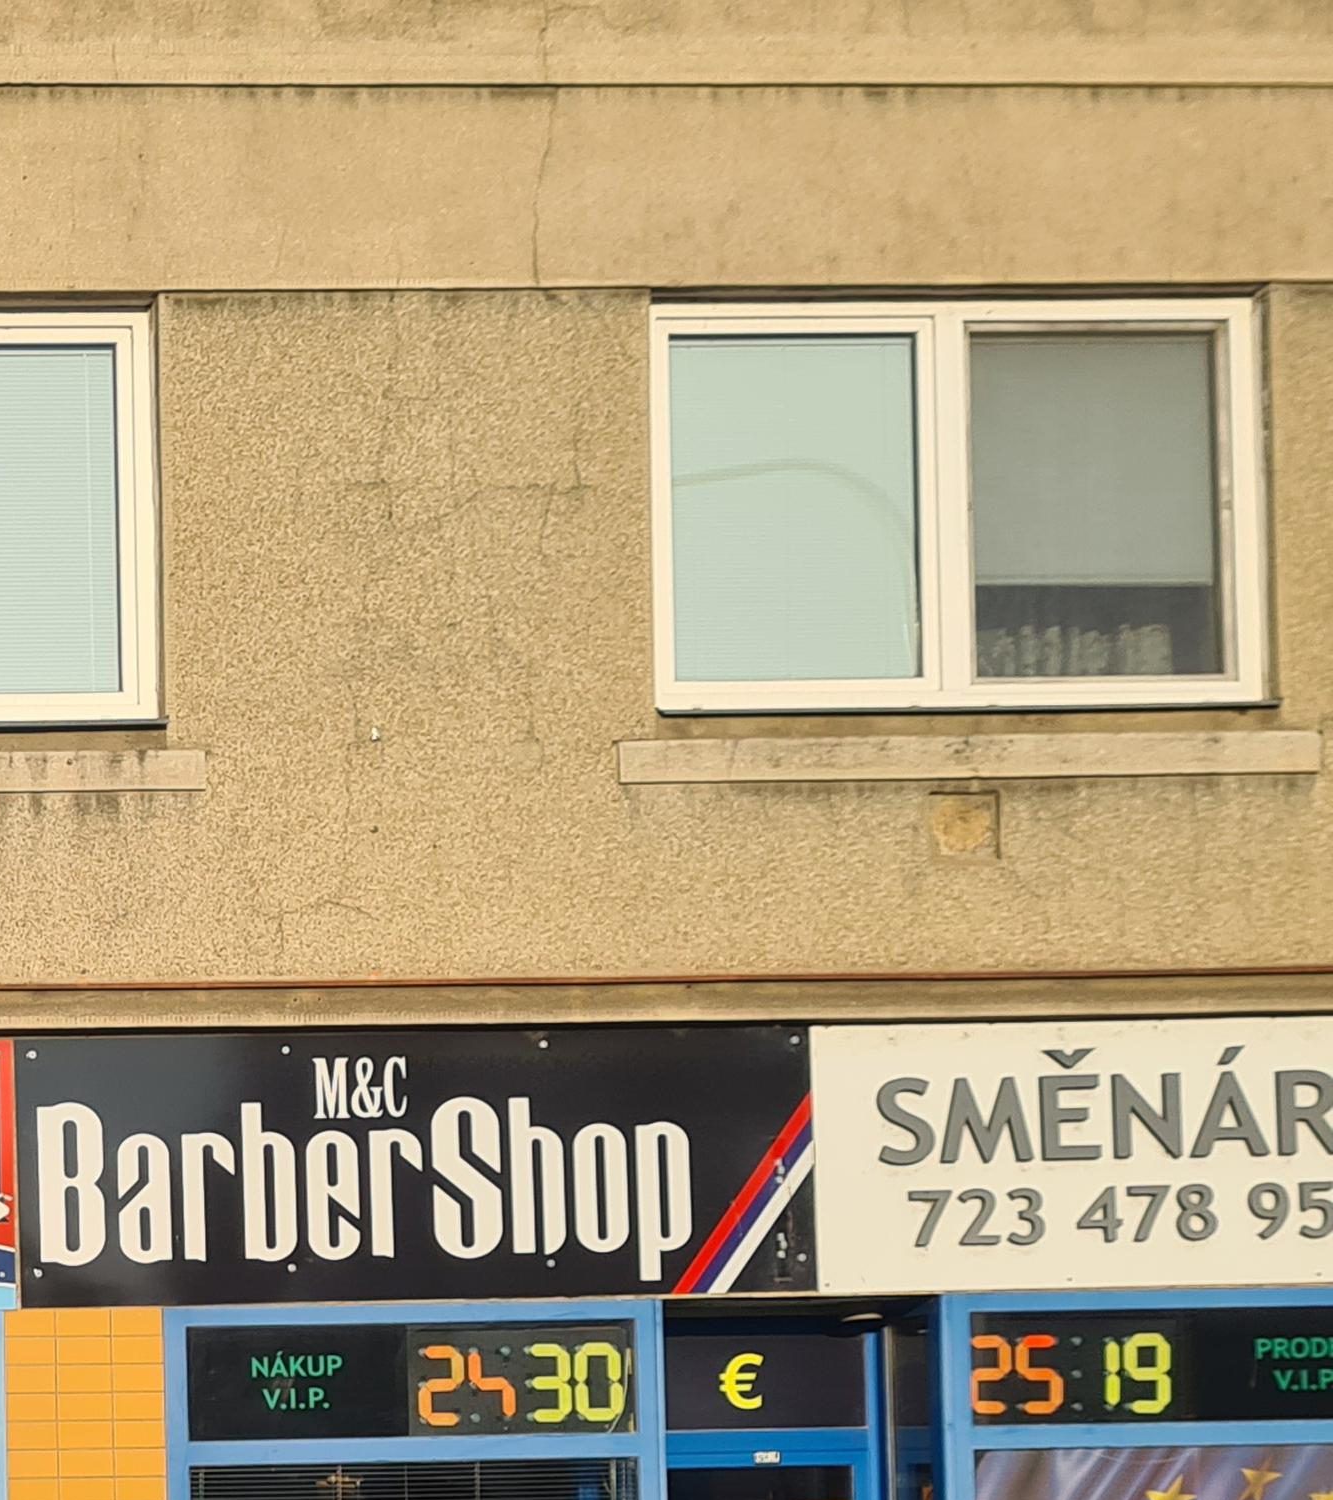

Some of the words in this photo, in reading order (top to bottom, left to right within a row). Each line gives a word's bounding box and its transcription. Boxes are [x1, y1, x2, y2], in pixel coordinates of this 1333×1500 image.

[312, 1056, 409, 1119] M&C
[34, 1096, 693, 1282] BarberShop
[907, 1188, 1046, 1248] 723
[1076, 1184, 1219, 1243] 478
[250, 1351, 343, 1379] NÁKUP
[1254, 1337, 1333, 1359] PROD
[262, 1386, 331, 1410] V.I.P.
[719, 1352, 764, 1410] €
